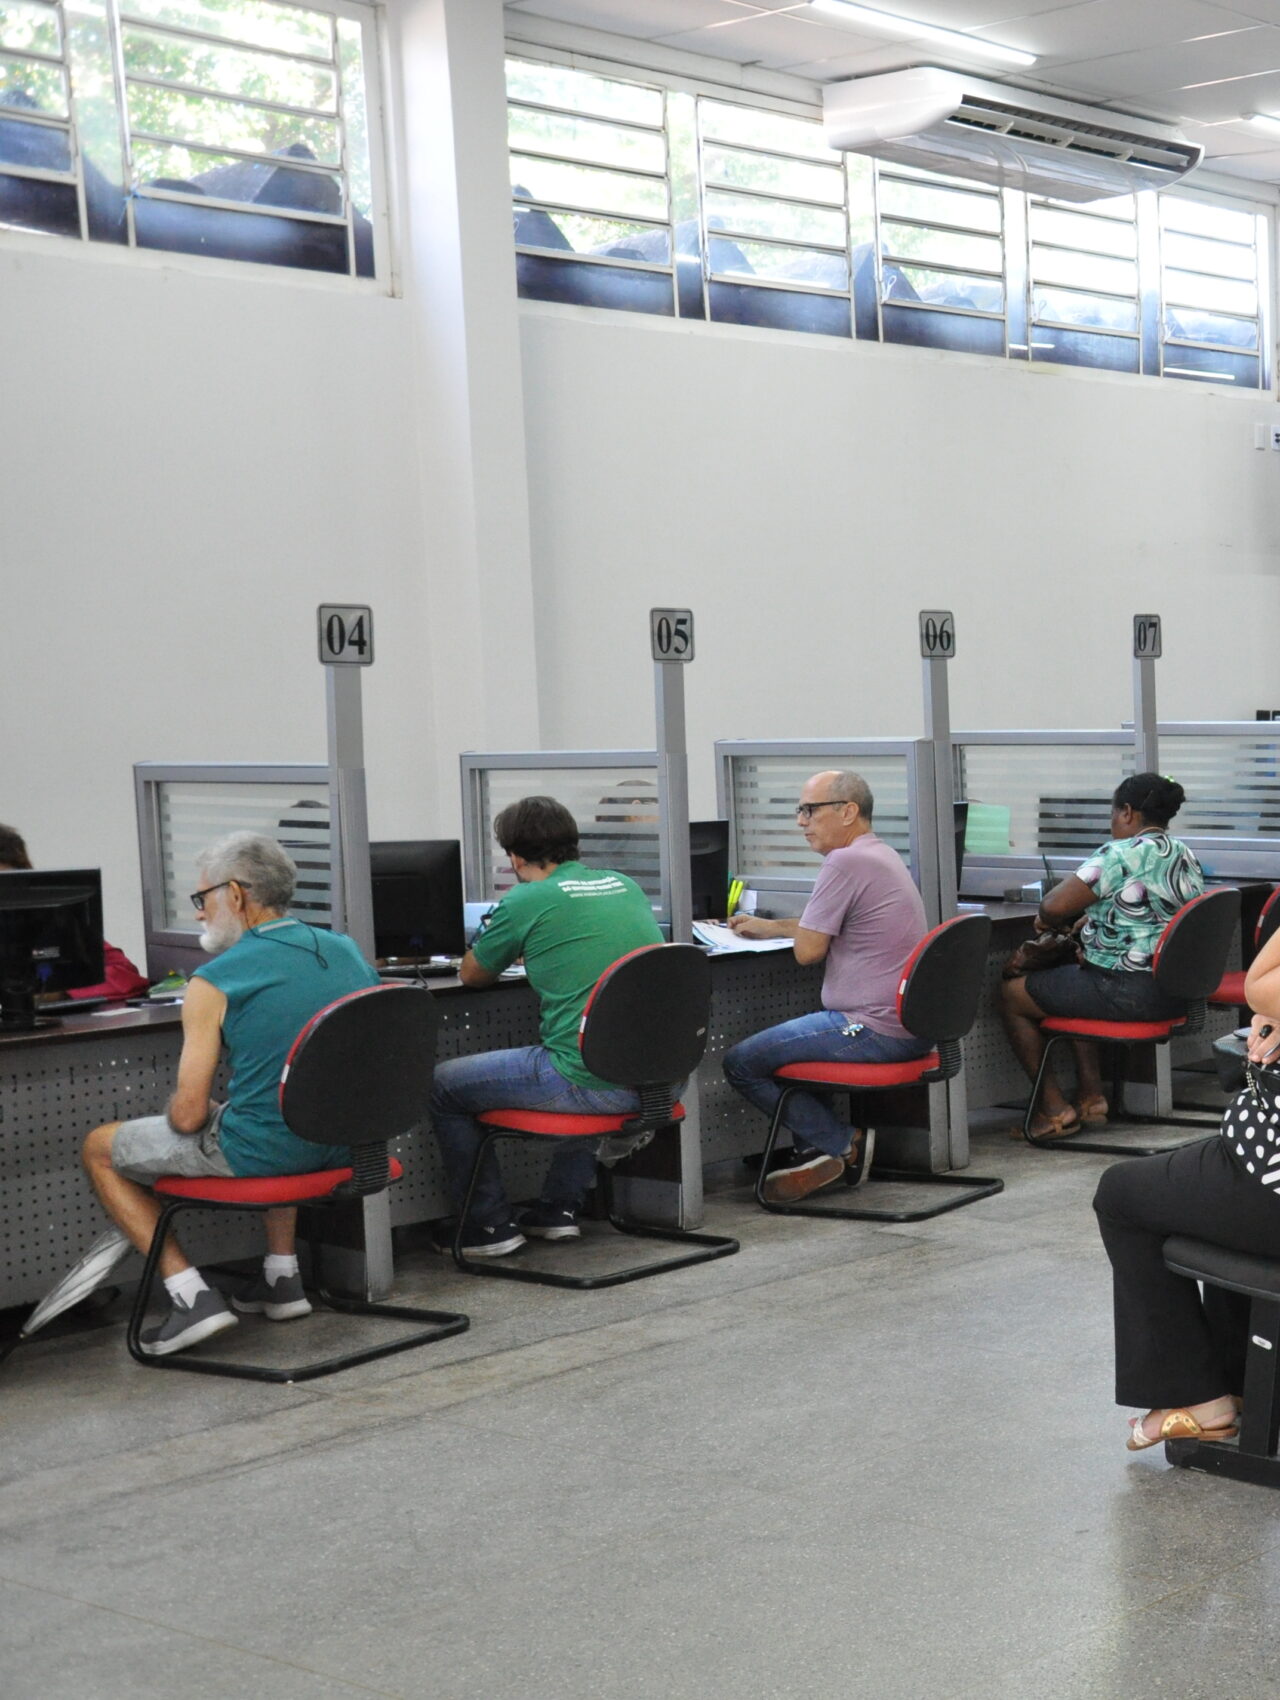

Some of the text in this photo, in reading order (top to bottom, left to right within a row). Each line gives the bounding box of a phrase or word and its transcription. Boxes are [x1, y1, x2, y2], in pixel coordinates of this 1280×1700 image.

[326, 614, 367, 656] 04
[657, 616, 689, 654] 05
[925, 617, 952, 651] 06
[1137, 621, 1158, 652] 07
